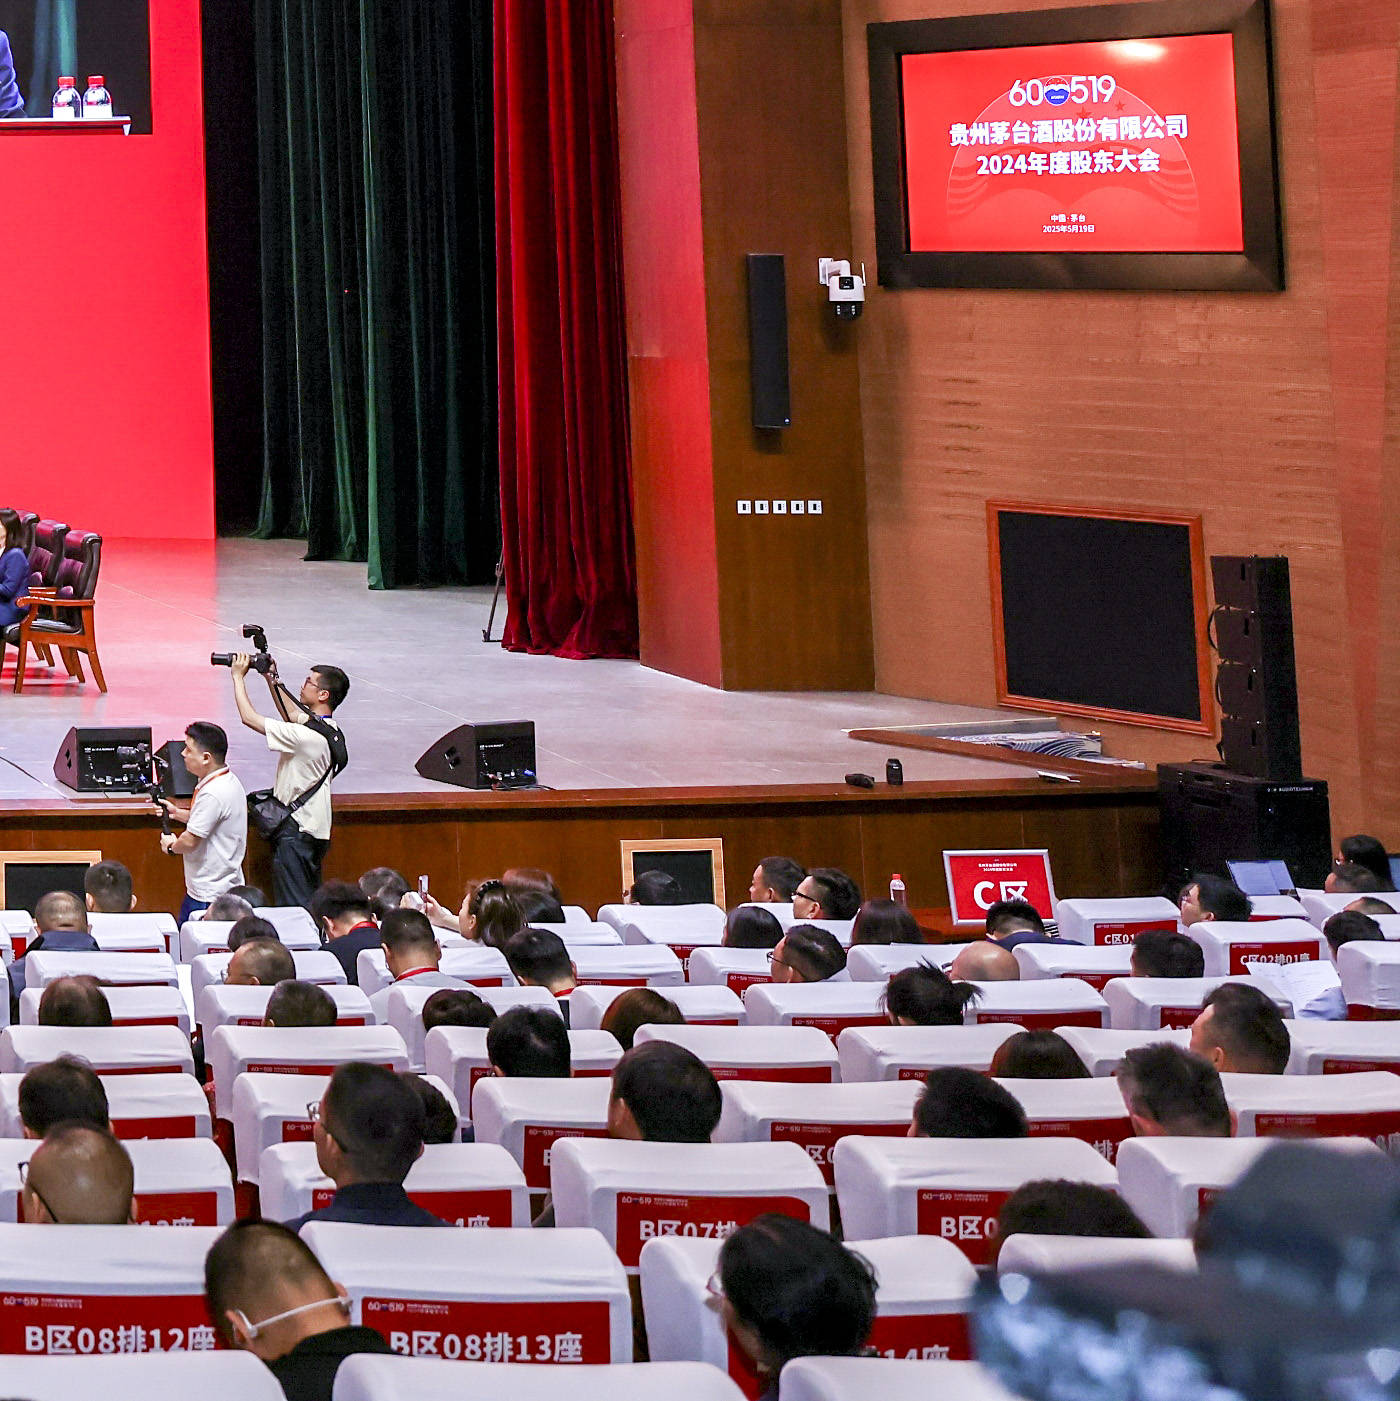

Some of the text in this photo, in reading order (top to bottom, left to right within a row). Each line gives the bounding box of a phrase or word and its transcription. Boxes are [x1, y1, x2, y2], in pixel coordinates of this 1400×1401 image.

[948, 113, 1189, 146] 贵州茅台酒股份有限公司
[976, 147, 1161, 176] 2024年度股东大会
[390, 1330, 583, 1363] B区08排13座
